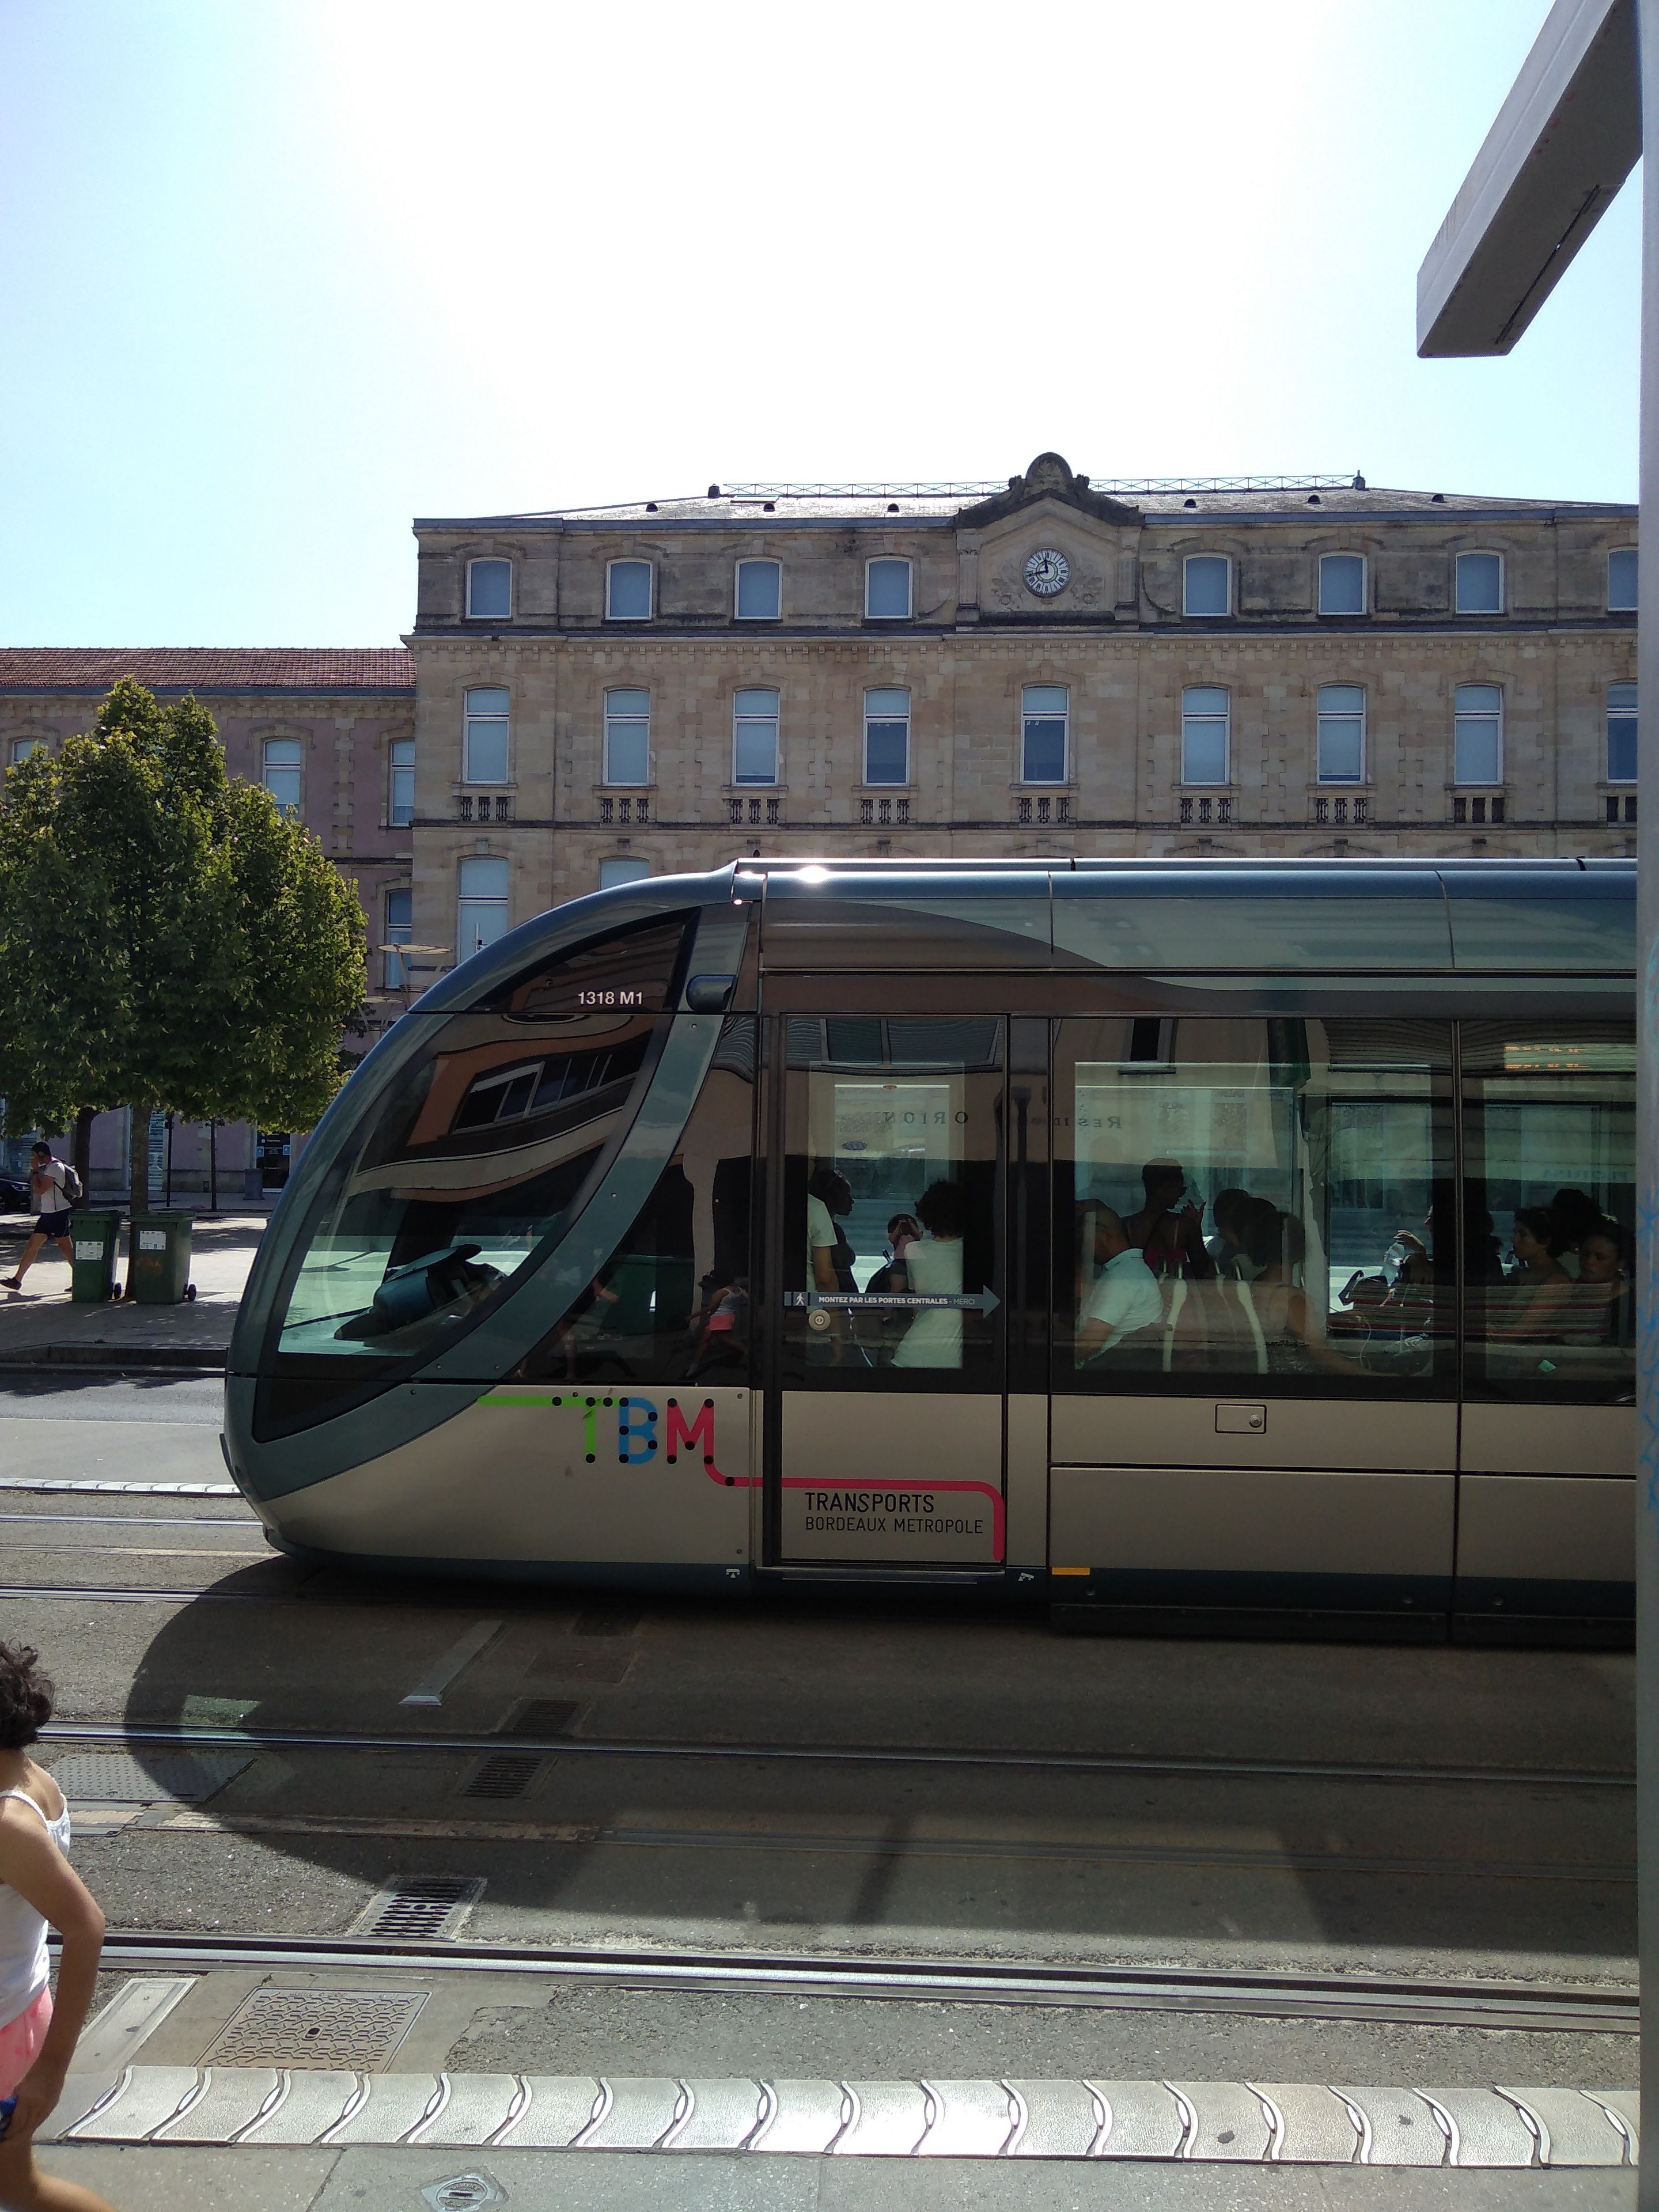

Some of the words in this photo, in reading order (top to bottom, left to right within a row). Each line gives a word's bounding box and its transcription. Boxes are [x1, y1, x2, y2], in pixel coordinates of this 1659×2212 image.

[578, 991, 615, 1005] 1318
[619, 991, 643, 1005] M1
[556, 1396, 714, 1465] TBM
[805, 1491, 935, 1514] TRANSPORTS
[806, 1516, 887, 1532] BORDEAUX
[893, 1517, 984, 1535] METROPOLE
